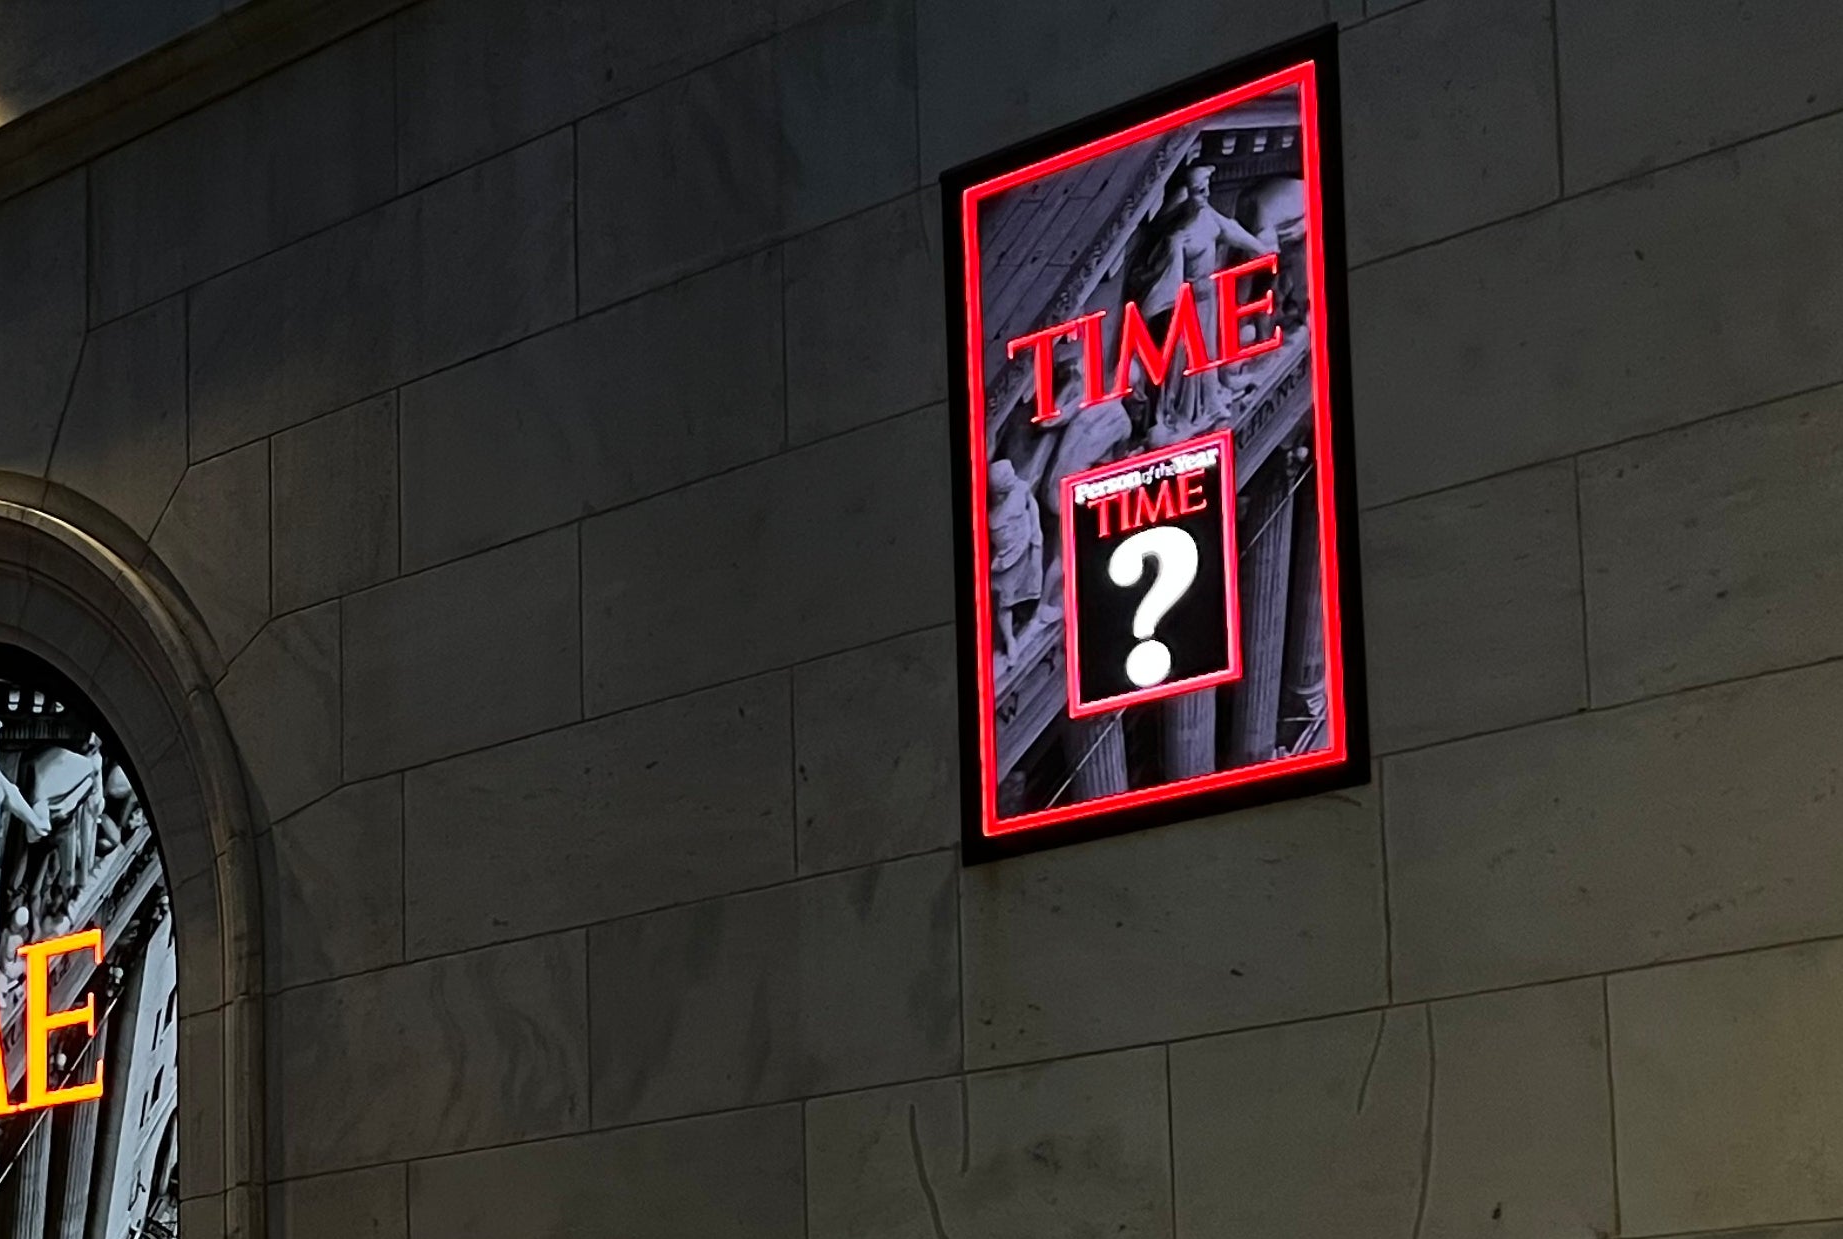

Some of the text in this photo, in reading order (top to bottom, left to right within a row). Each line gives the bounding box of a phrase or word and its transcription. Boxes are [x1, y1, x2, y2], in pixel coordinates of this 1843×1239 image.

[1006, 252, 1283, 424] TIME
[1075, 447, 1219, 505] Person of the Year
[1087, 468, 1207, 539] TIME
[1108, 525, 1199, 689] ?
